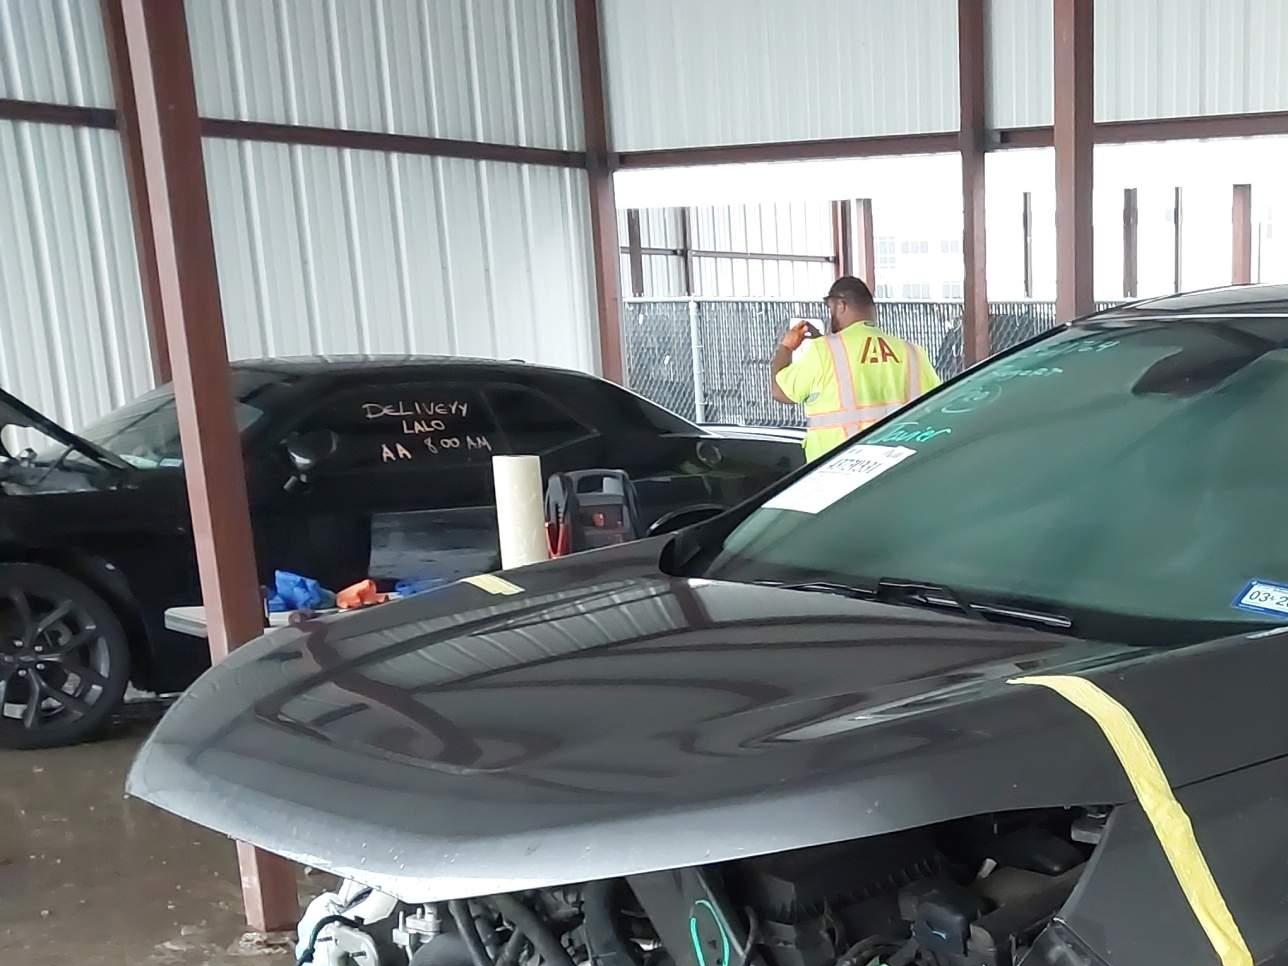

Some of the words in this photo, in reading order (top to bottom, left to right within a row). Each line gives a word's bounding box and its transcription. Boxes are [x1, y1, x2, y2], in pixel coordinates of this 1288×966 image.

[402, 420, 445, 433] LALO
[381, 443, 412, 462] AA
[466, 435, 492, 452] AM
[1249, 590, 1271, 602] 03
